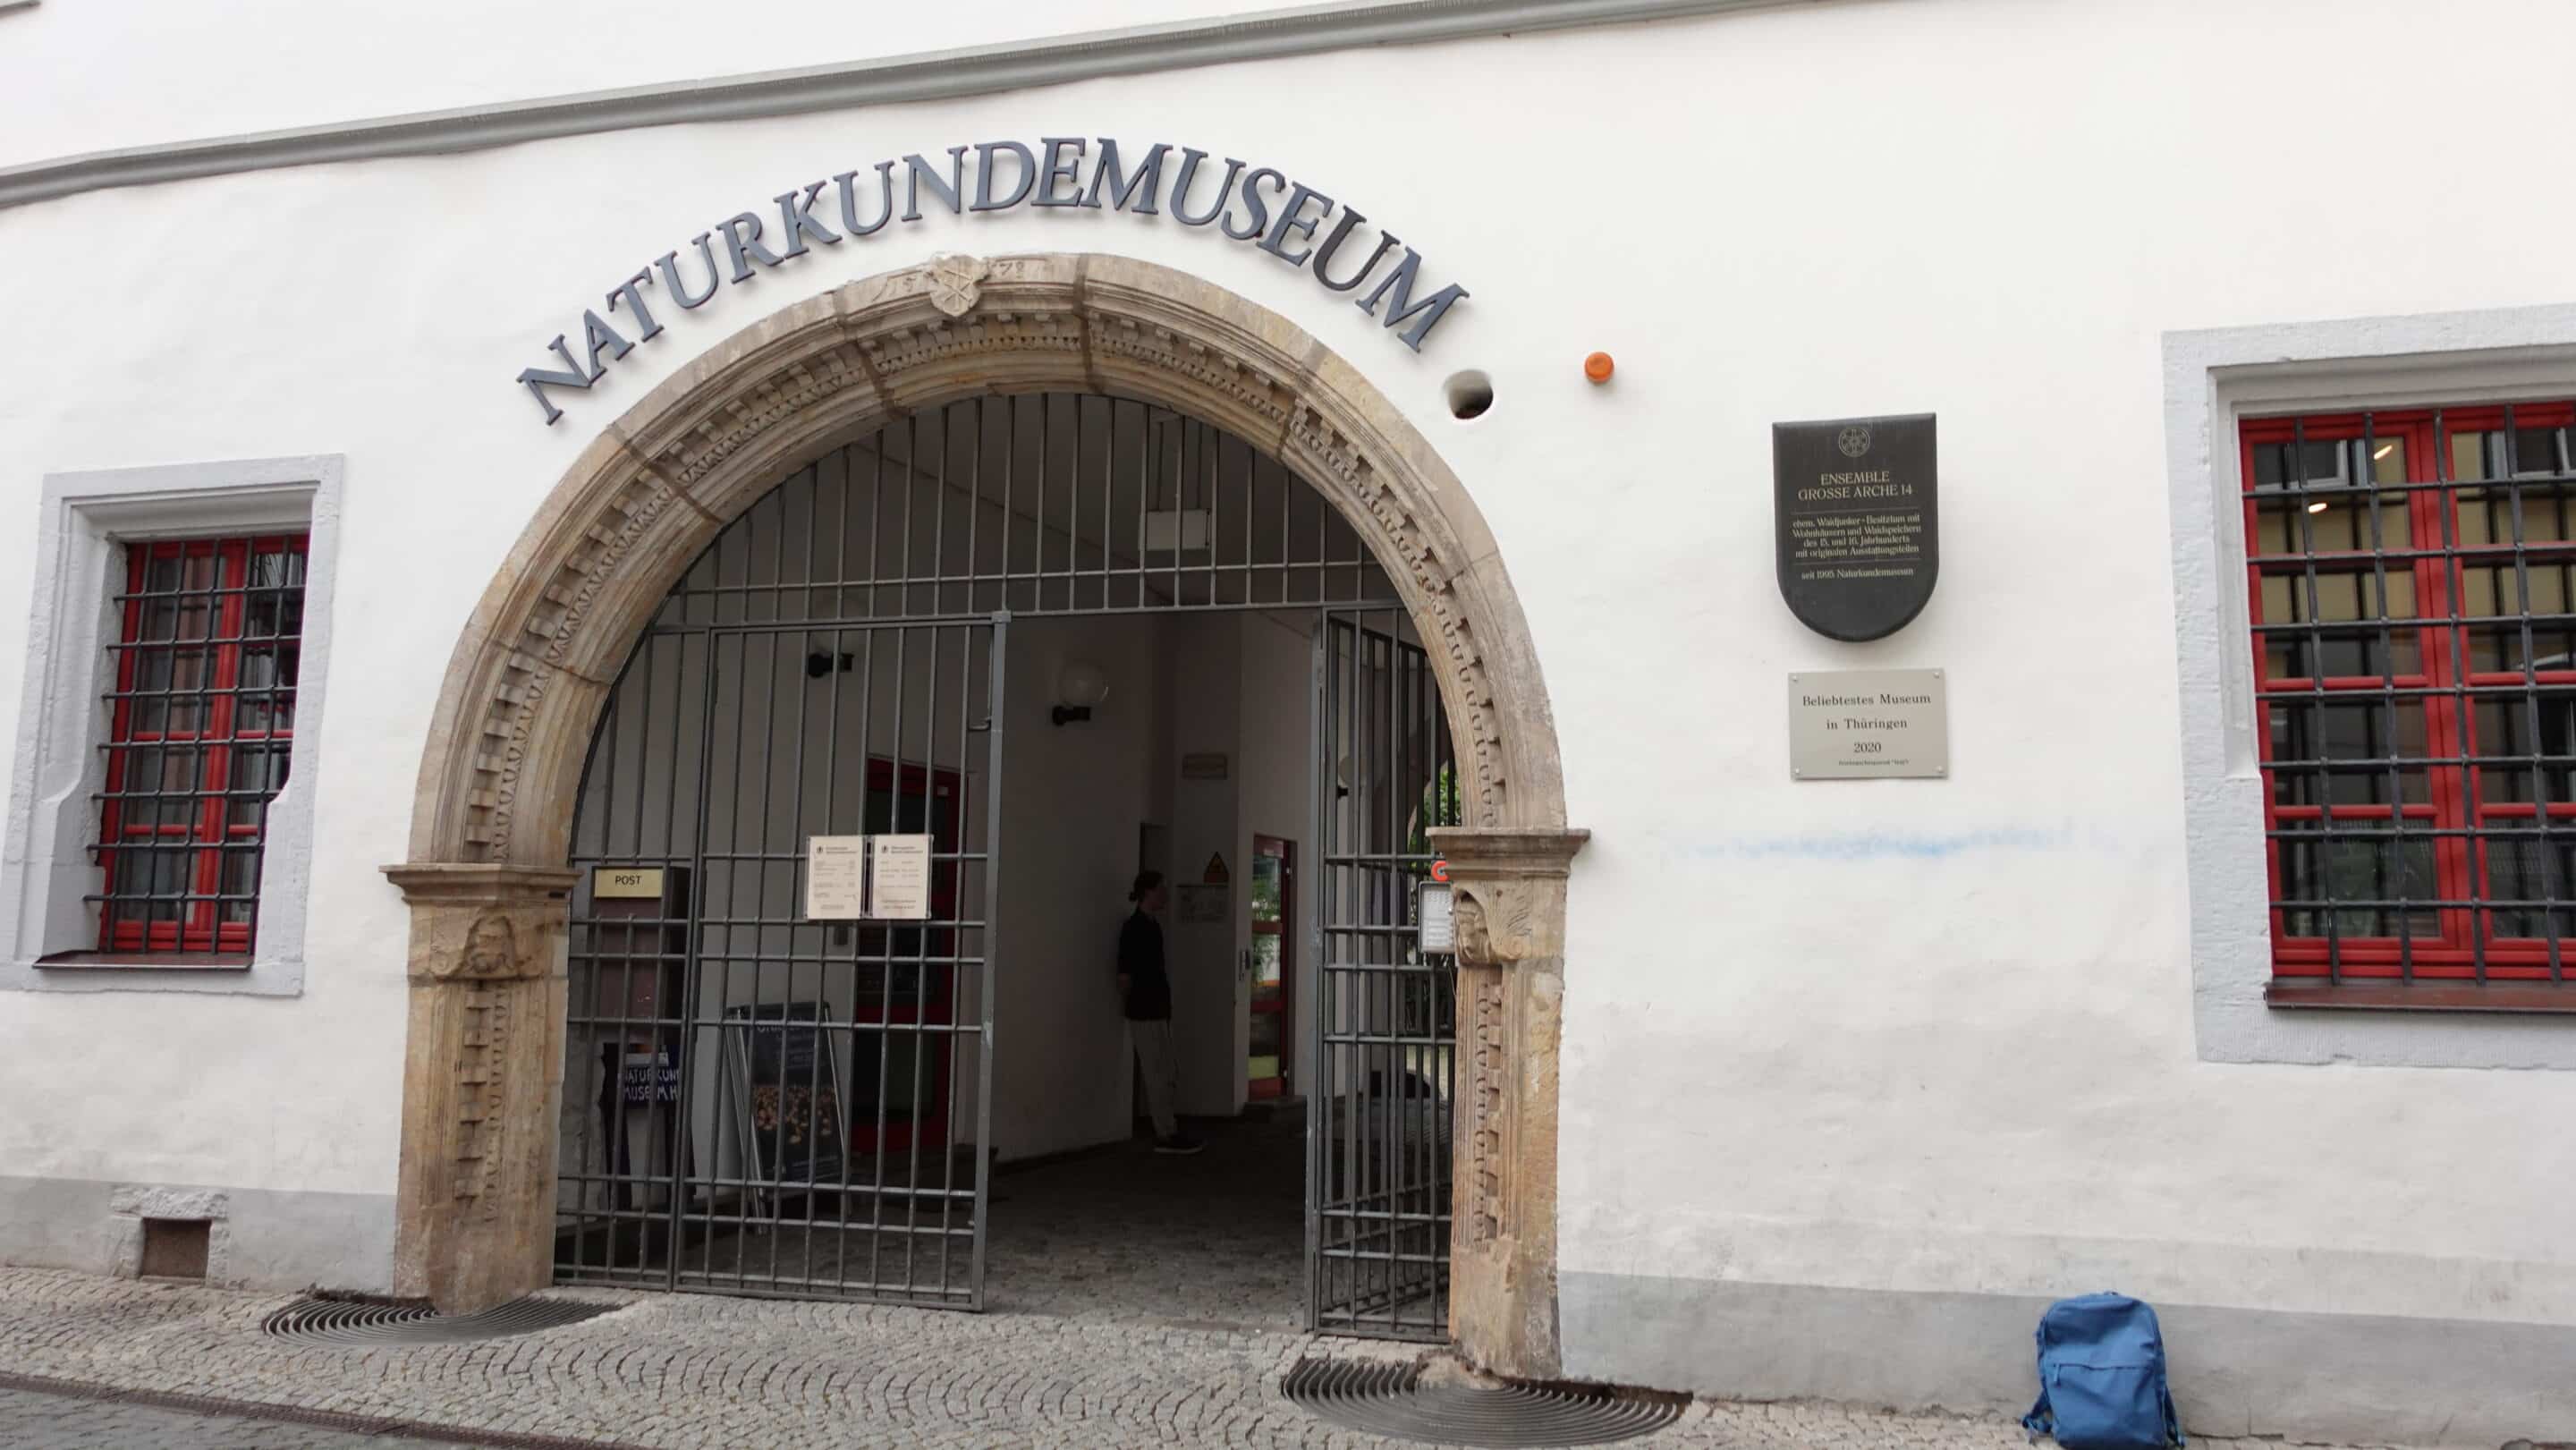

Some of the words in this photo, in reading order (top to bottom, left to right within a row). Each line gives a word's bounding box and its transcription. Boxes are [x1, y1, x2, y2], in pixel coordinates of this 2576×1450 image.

[516, 136, 1470, 426] NATURKUNDEMUSEUM
[1820, 471, 1890, 486] ENSEMBLE
[1798, 486, 1851, 501] GROSSE
[1853, 483, 1899, 498] ARCHE
[1901, 483, 1913, 496] 14
[1907, 513, 1919, 523] mit
[1847, 525, 1861, 537] und
[1803, 538, 1818, 548] des
[1831, 536, 1846, 547] und
[1860, 534, 1911, 547] Jahrhunderts
[1795, 548, 1809, 558] mit
[1809, 547, 1848, 559] originalen
[1801, 570, 1815, 580] seit
[1837, 567, 1914, 579] Naturkundemuseum
[1802, 694, 1875, 708] Beliebtestes
[1879, 693, 1932, 705] Museum
[1826, 719, 1838, 730] in
[1843, 717, 1908, 731] Thüringen
[1853, 742, 1882, 753] 2020
[614, 875, 642, 886] POST
